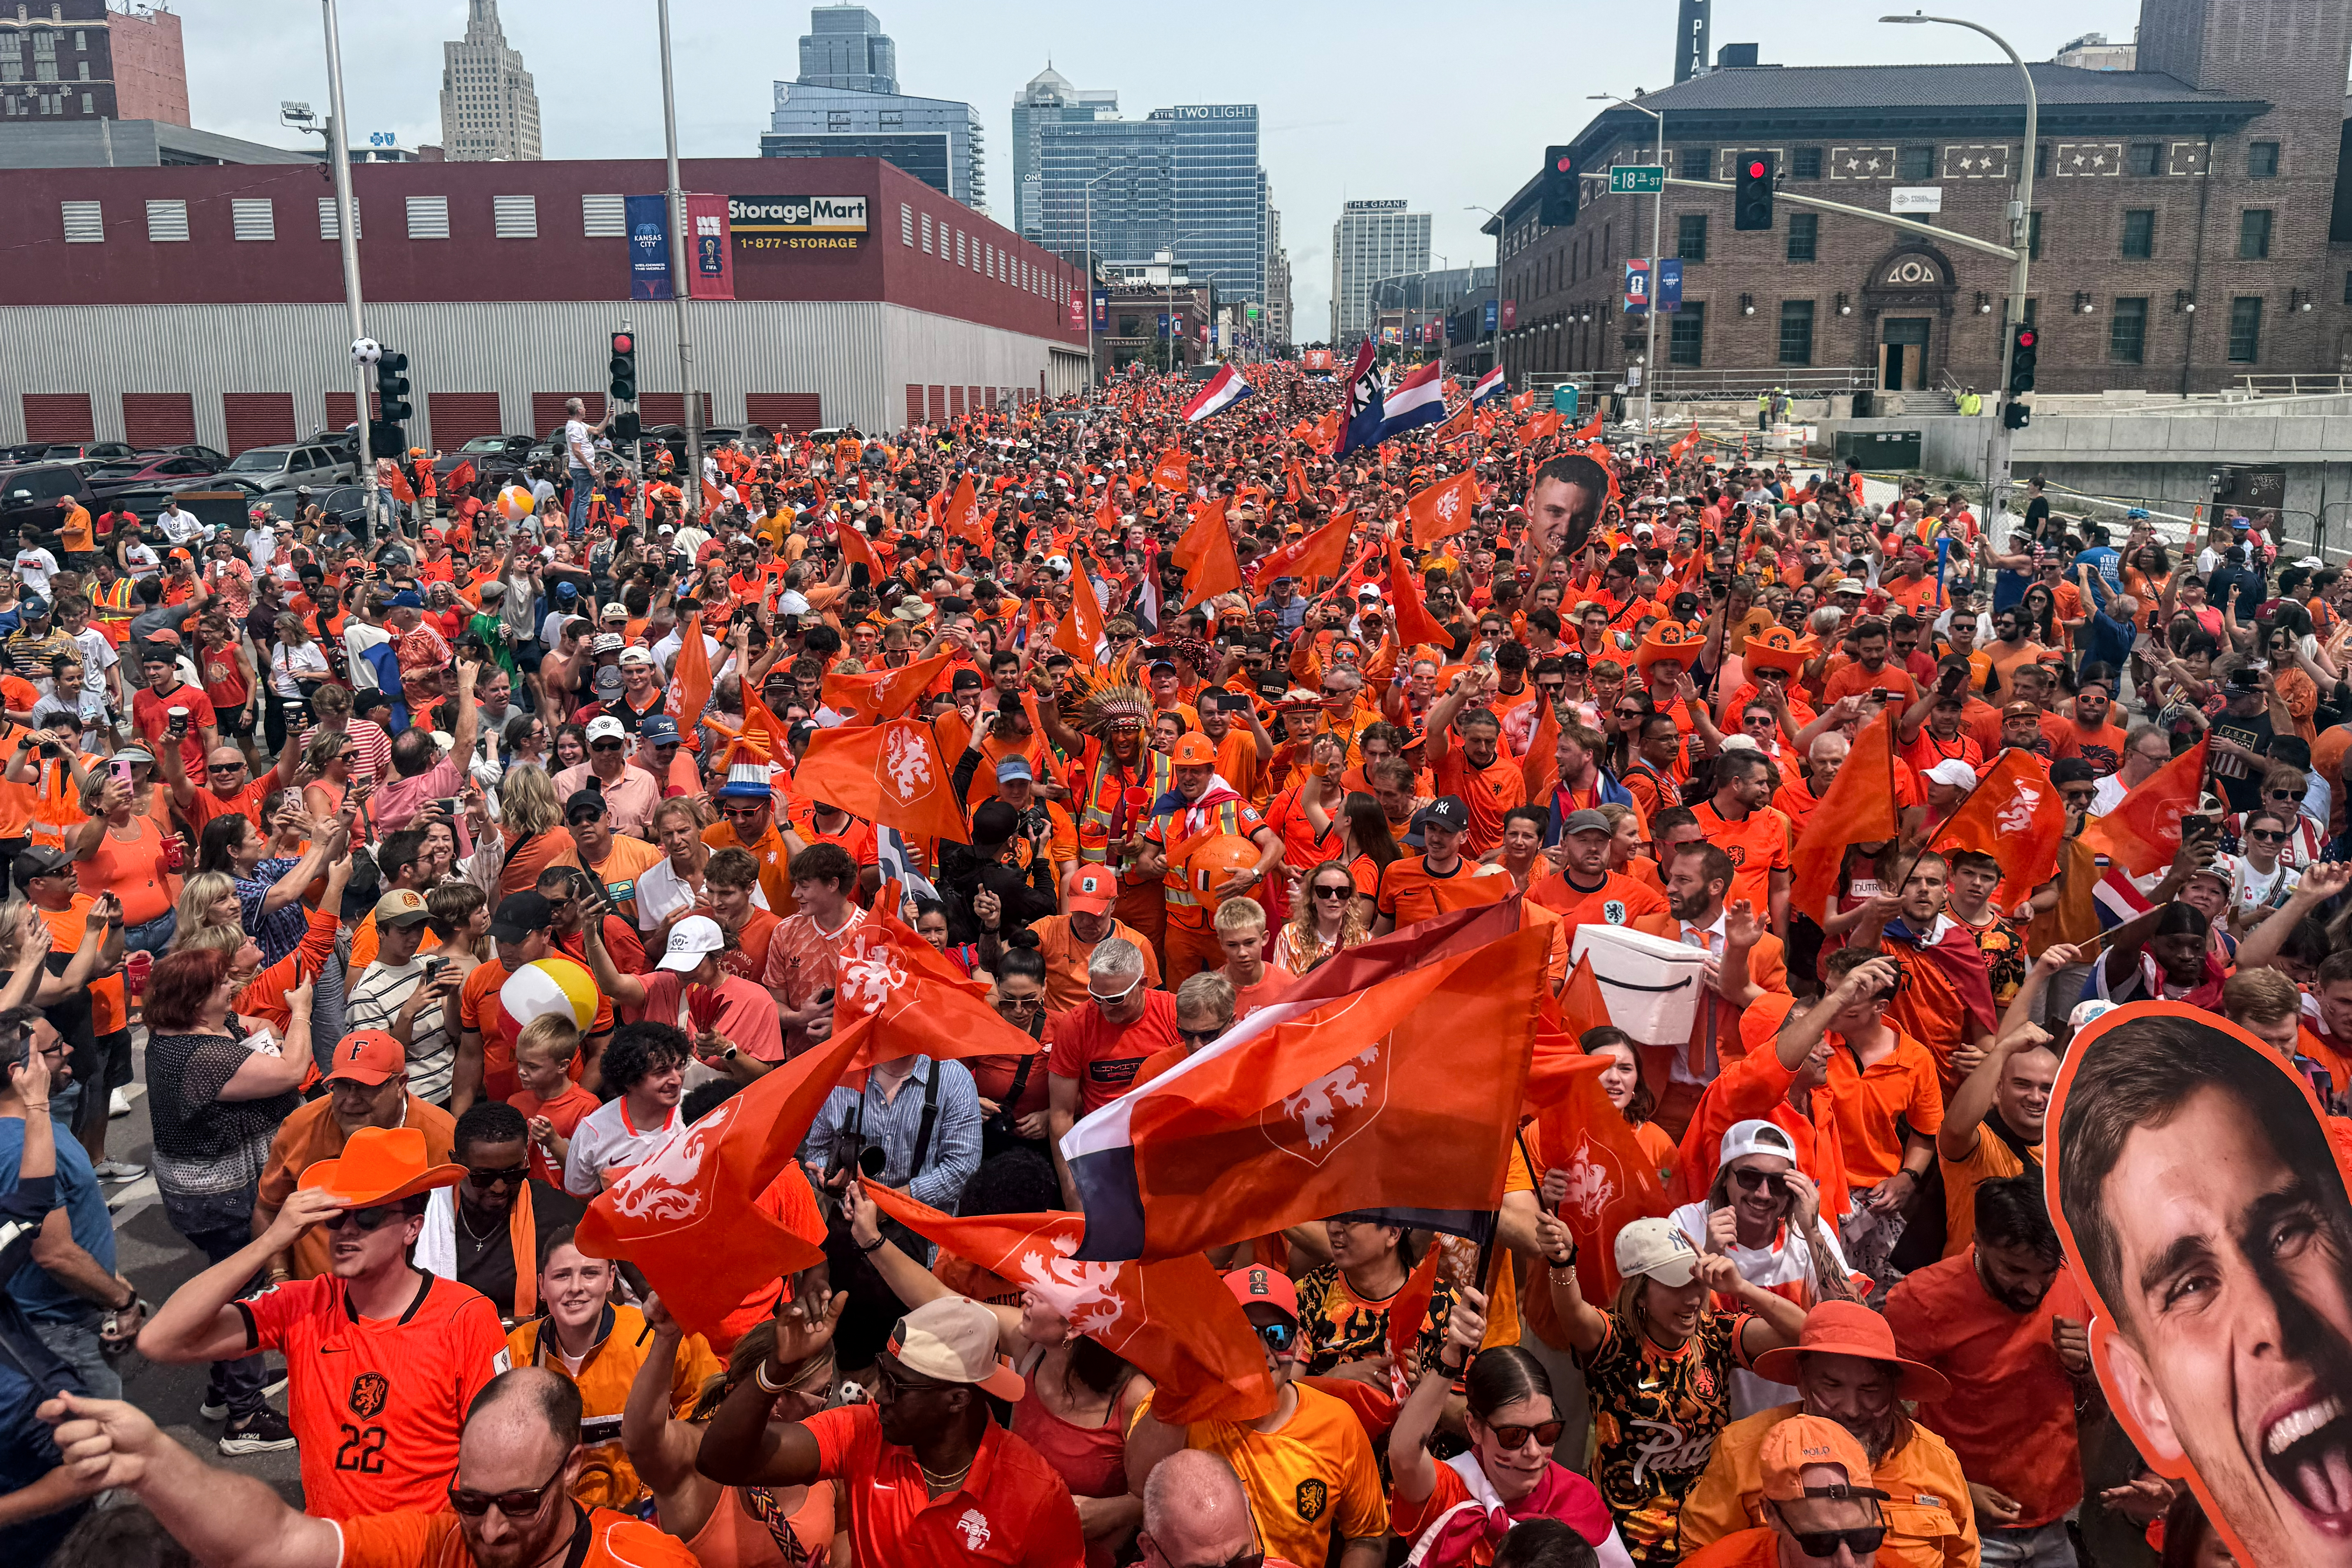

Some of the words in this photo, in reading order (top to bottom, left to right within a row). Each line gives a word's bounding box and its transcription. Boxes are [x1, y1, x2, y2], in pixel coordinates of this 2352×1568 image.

[1176, 107, 1208, 118] TWO
[1213, 106, 1252, 118] LIGHT
[1650, 177, 1661, 186] ST
[696, 216, 720, 227] WE
[741, 238, 857, 249] 1-877-STORAGE
[1435, 801, 1449, 814] NY
[348, 1040, 369, 1060] F
[336, 1423, 387, 1474] 22
